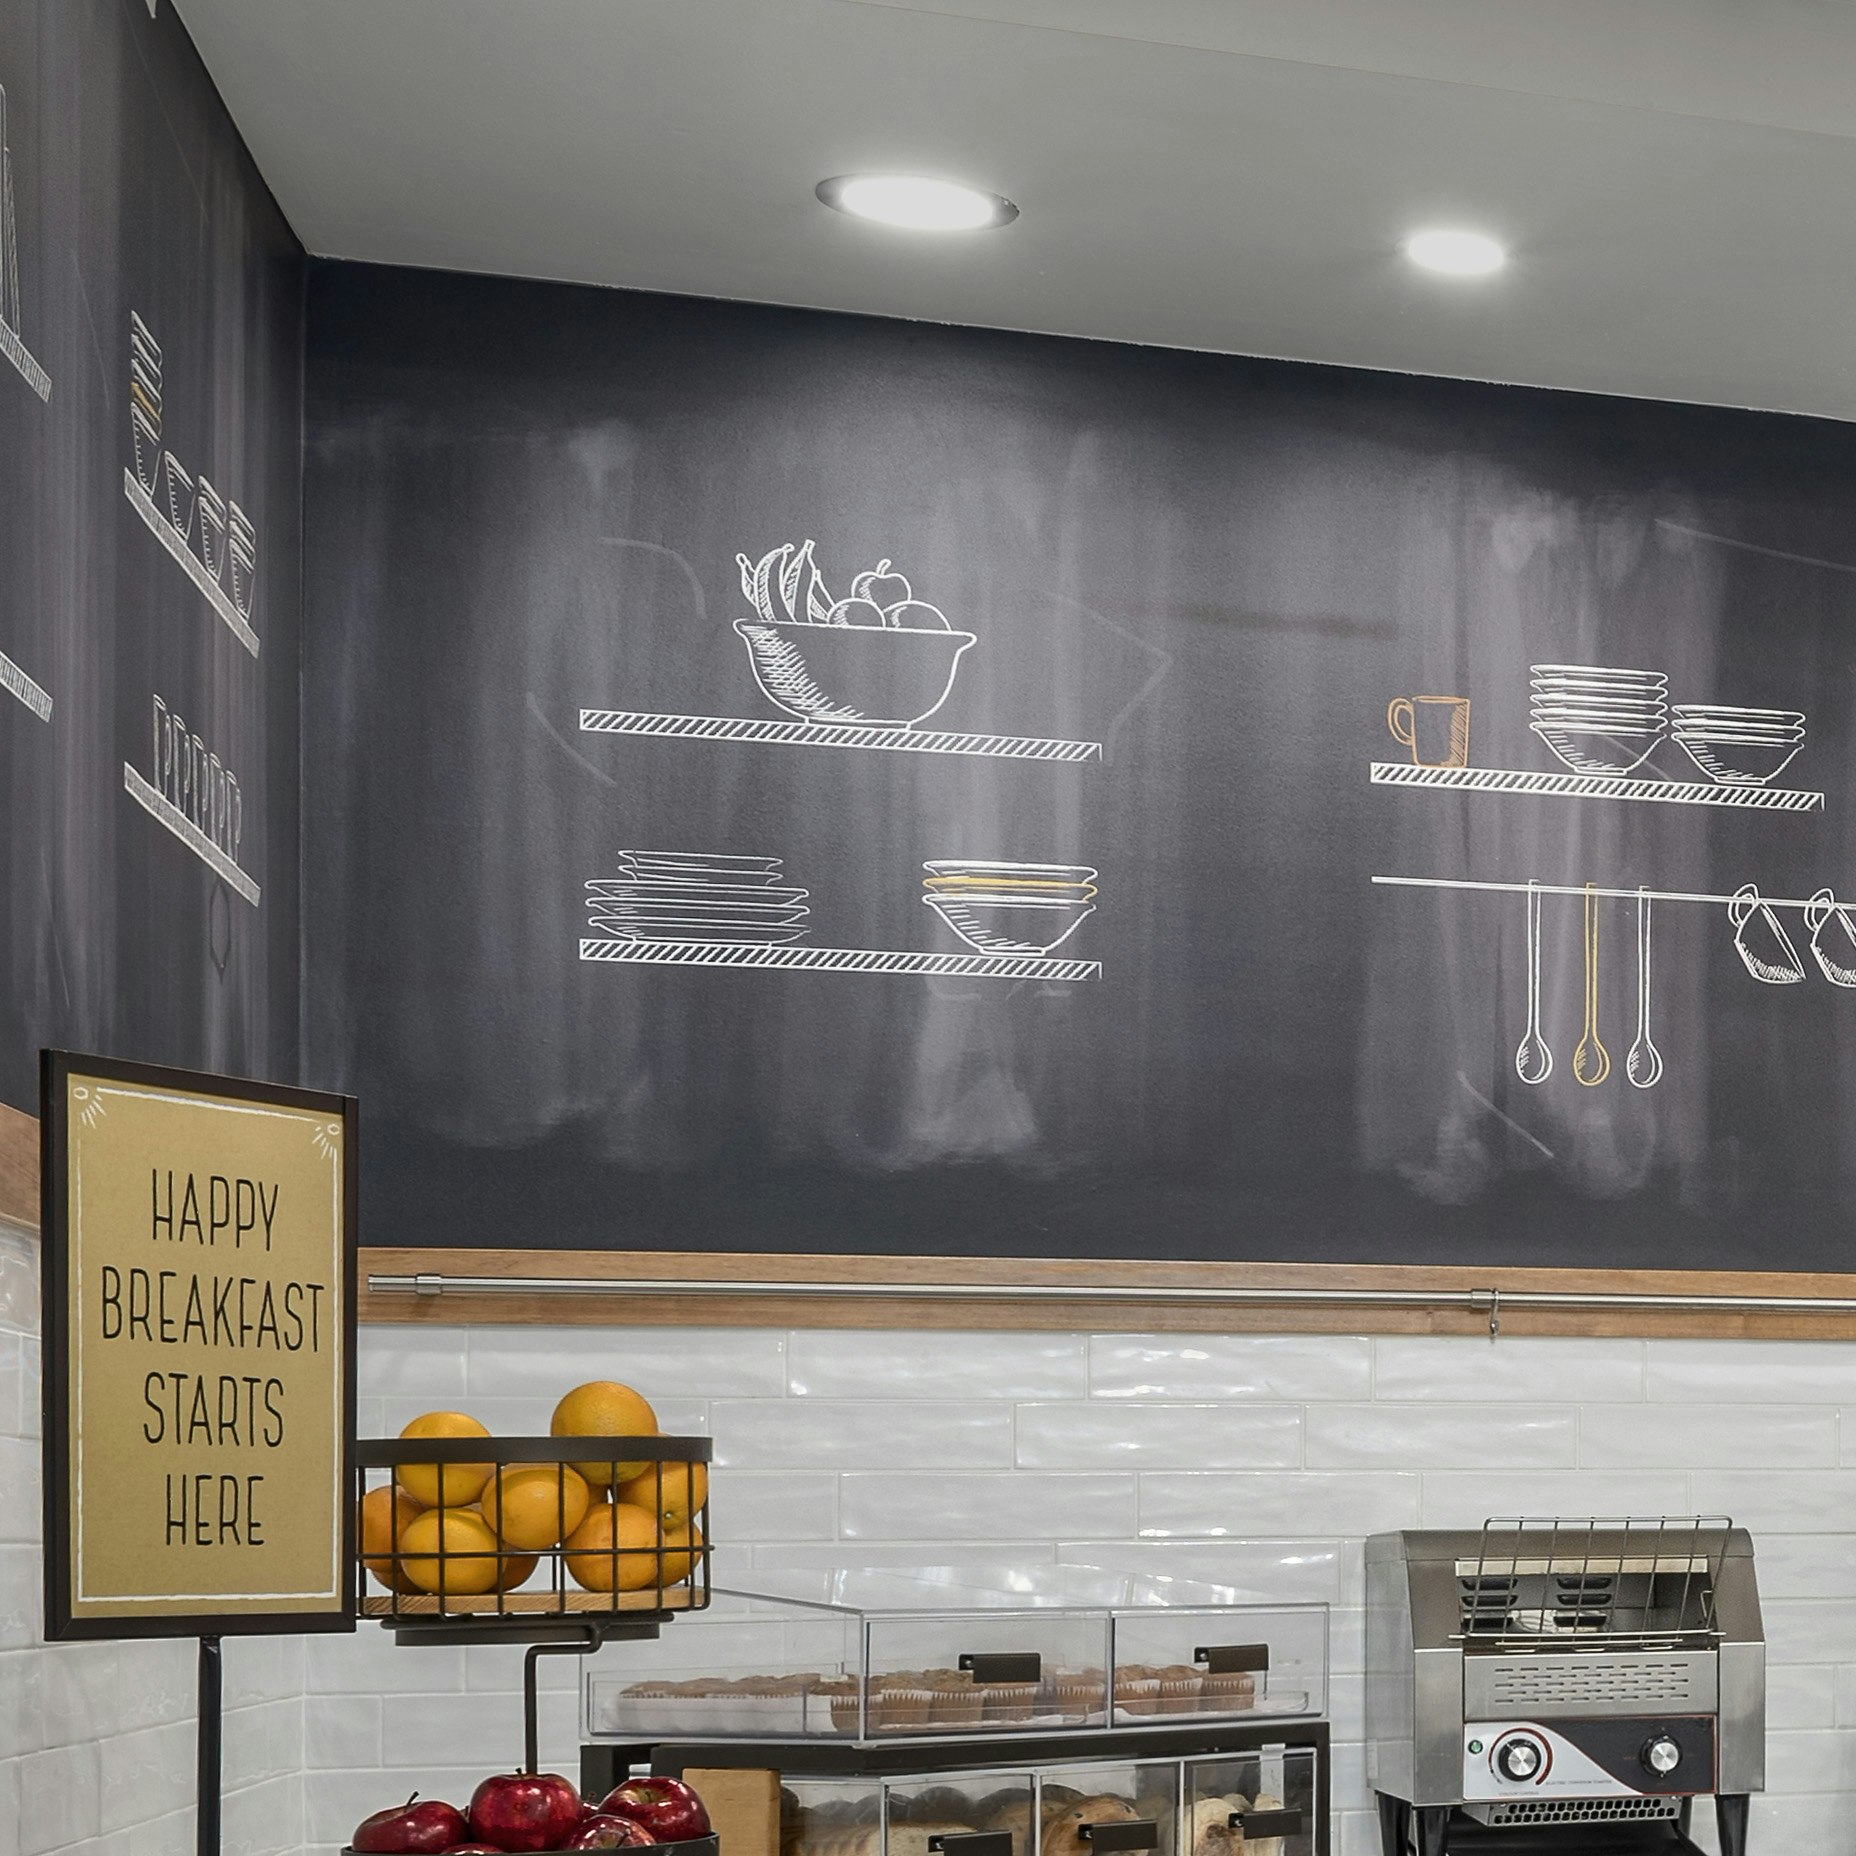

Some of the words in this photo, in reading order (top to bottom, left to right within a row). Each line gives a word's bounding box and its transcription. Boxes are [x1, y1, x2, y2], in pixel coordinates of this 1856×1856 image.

[152, 1168, 278, 1252] HAPPY
[102, 1266, 325, 1353] BREAKFAST
[143, 1371, 284, 1448] STARTS
[166, 1474, 265, 1546] HERE
